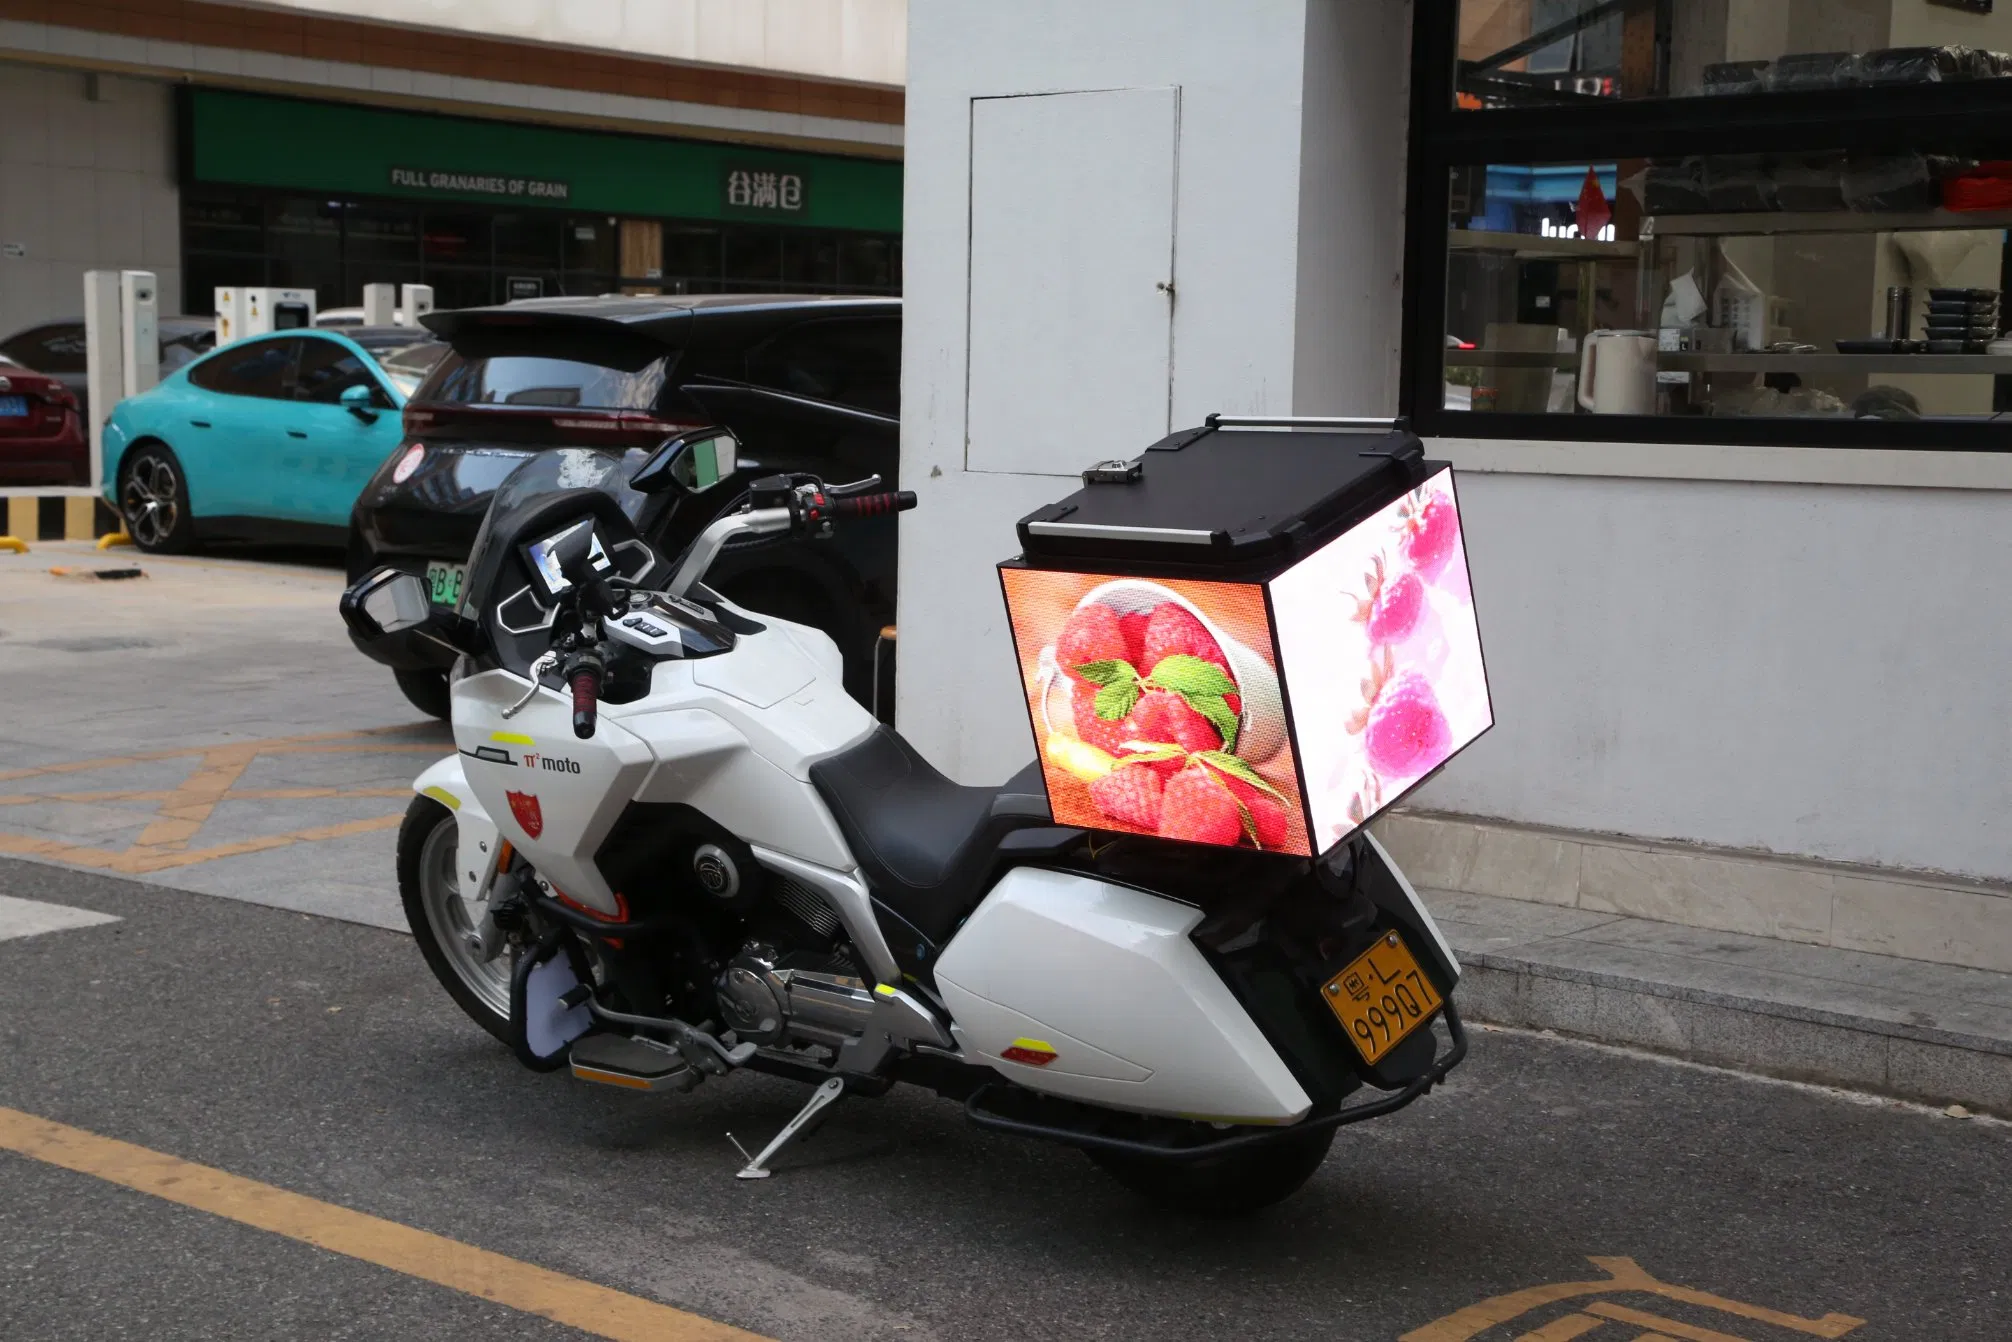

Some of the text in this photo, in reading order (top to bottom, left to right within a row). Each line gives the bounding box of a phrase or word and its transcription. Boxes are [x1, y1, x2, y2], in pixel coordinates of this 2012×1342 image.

[392, 168, 568, 199] FULL GRANARIES OF GRAIN
[541, 757, 581, 774] moto
